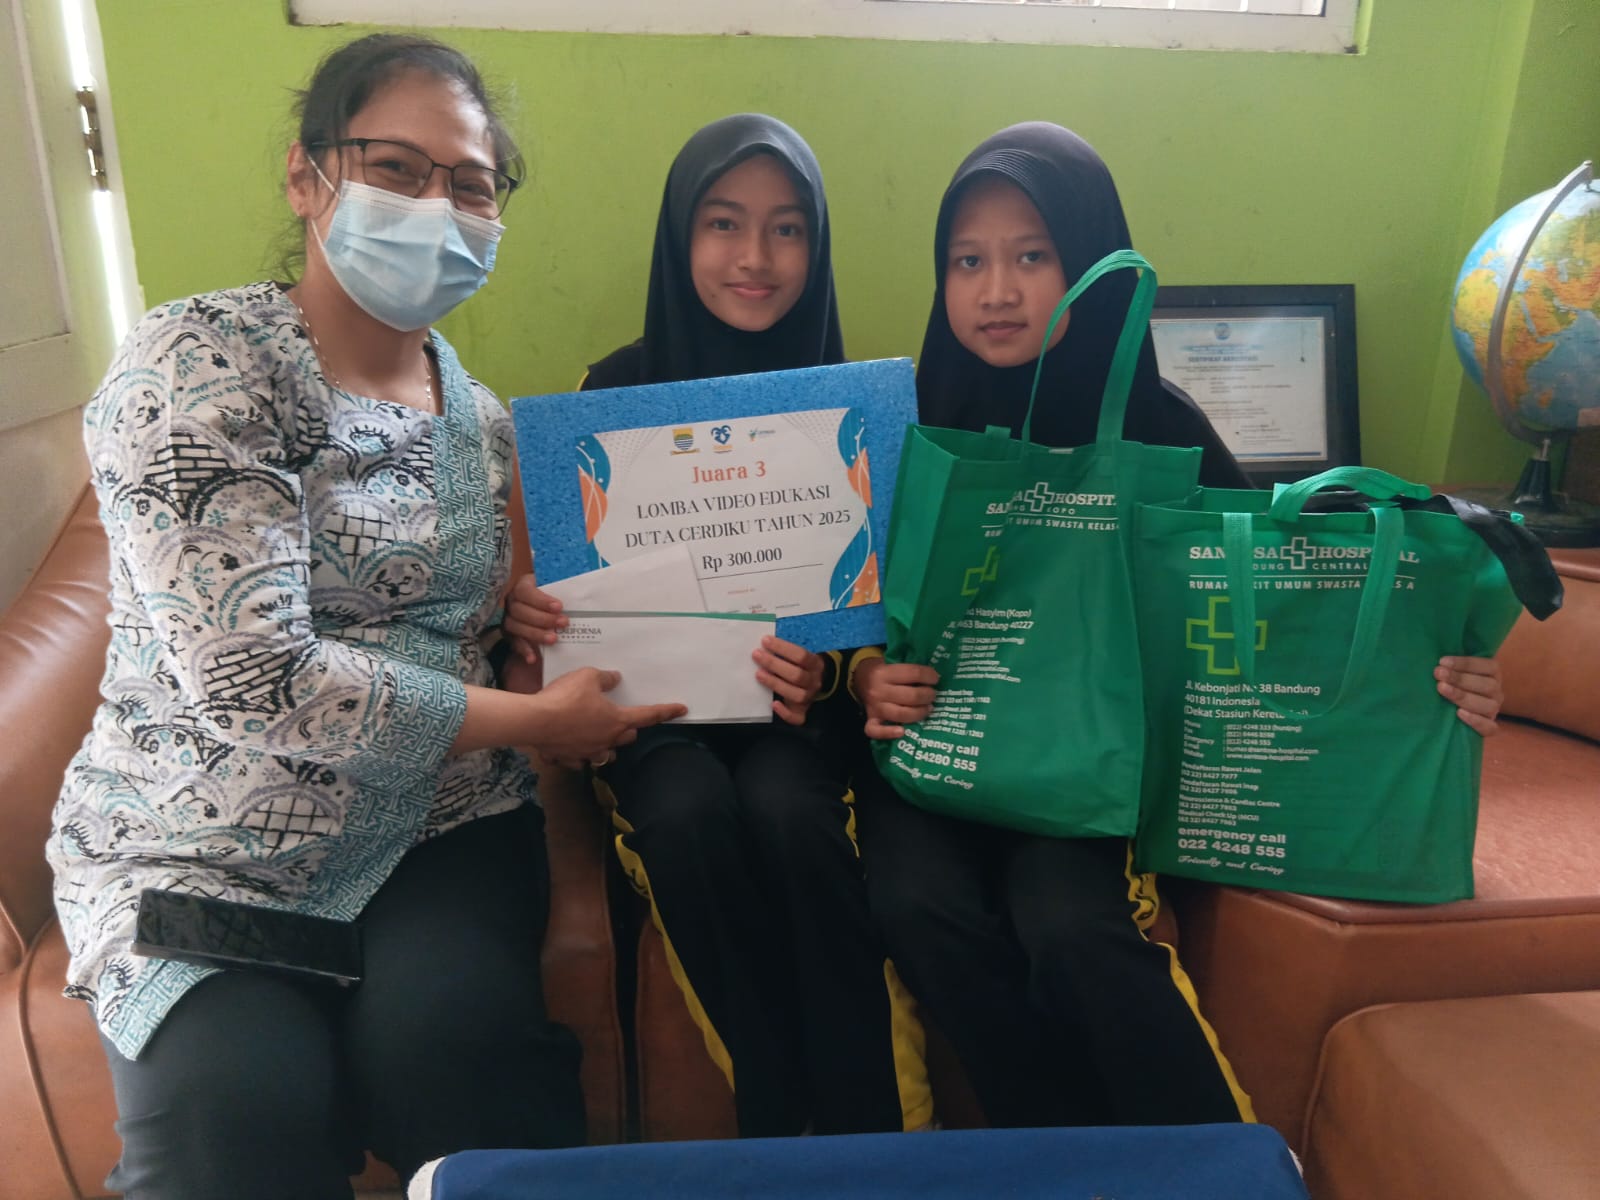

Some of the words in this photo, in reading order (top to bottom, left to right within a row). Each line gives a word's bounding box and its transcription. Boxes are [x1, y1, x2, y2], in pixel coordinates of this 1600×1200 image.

[692, 465, 748, 484] Juara
[755, 460, 767, 477] 3
[636, 501, 700, 520] LOMBA
[703, 493, 756, 511] VIDEO
[760, 485, 831, 506] EDUKASI
[1053, 493, 1117, 506] HOSPIT
[625, 530, 676, 548] DUTA
[679, 521, 752, 542] CERDIKU
[754, 513, 814, 533] TAHUN
[818, 509, 851, 526] 2025
[1045, 519, 1084, 529] SWASTA
[1088, 522, 1115, 531] KELAS
[1189, 546, 1277, 560] SANSA
[702, 555, 723, 573] Rp
[727, 548, 783, 567] 300.000
[1312, 562, 1368, 570] CENTRAL
[1275, 580, 1312, 590] UMUM
[1316, 580, 1361, 589] SWASTA
[974, 620, 1009, 632] Bandung
[1194, 682, 1241, 695] Kebonjati
[1259, 684, 1272, 693] 38
[1274, 683, 1321, 696] Bandung
[1184, 693, 1211, 704] 40181
[1212, 696, 1261, 706] Indonesia
[1215, 708, 1251, 718] Stasiun
[956, 745, 980, 757] call
[915, 750, 951, 766] 54280
[953, 758, 977, 772] 555
[944, 775, 974, 790] Caring
[1178, 827, 1256, 843] emergency
[1259, 833, 1287, 844] call
[1178, 839, 1207, 849] 022
[1211, 841, 1251, 855] 4248
[1255, 845, 1286, 858] 555
[1249, 862, 1284, 875] Caring
